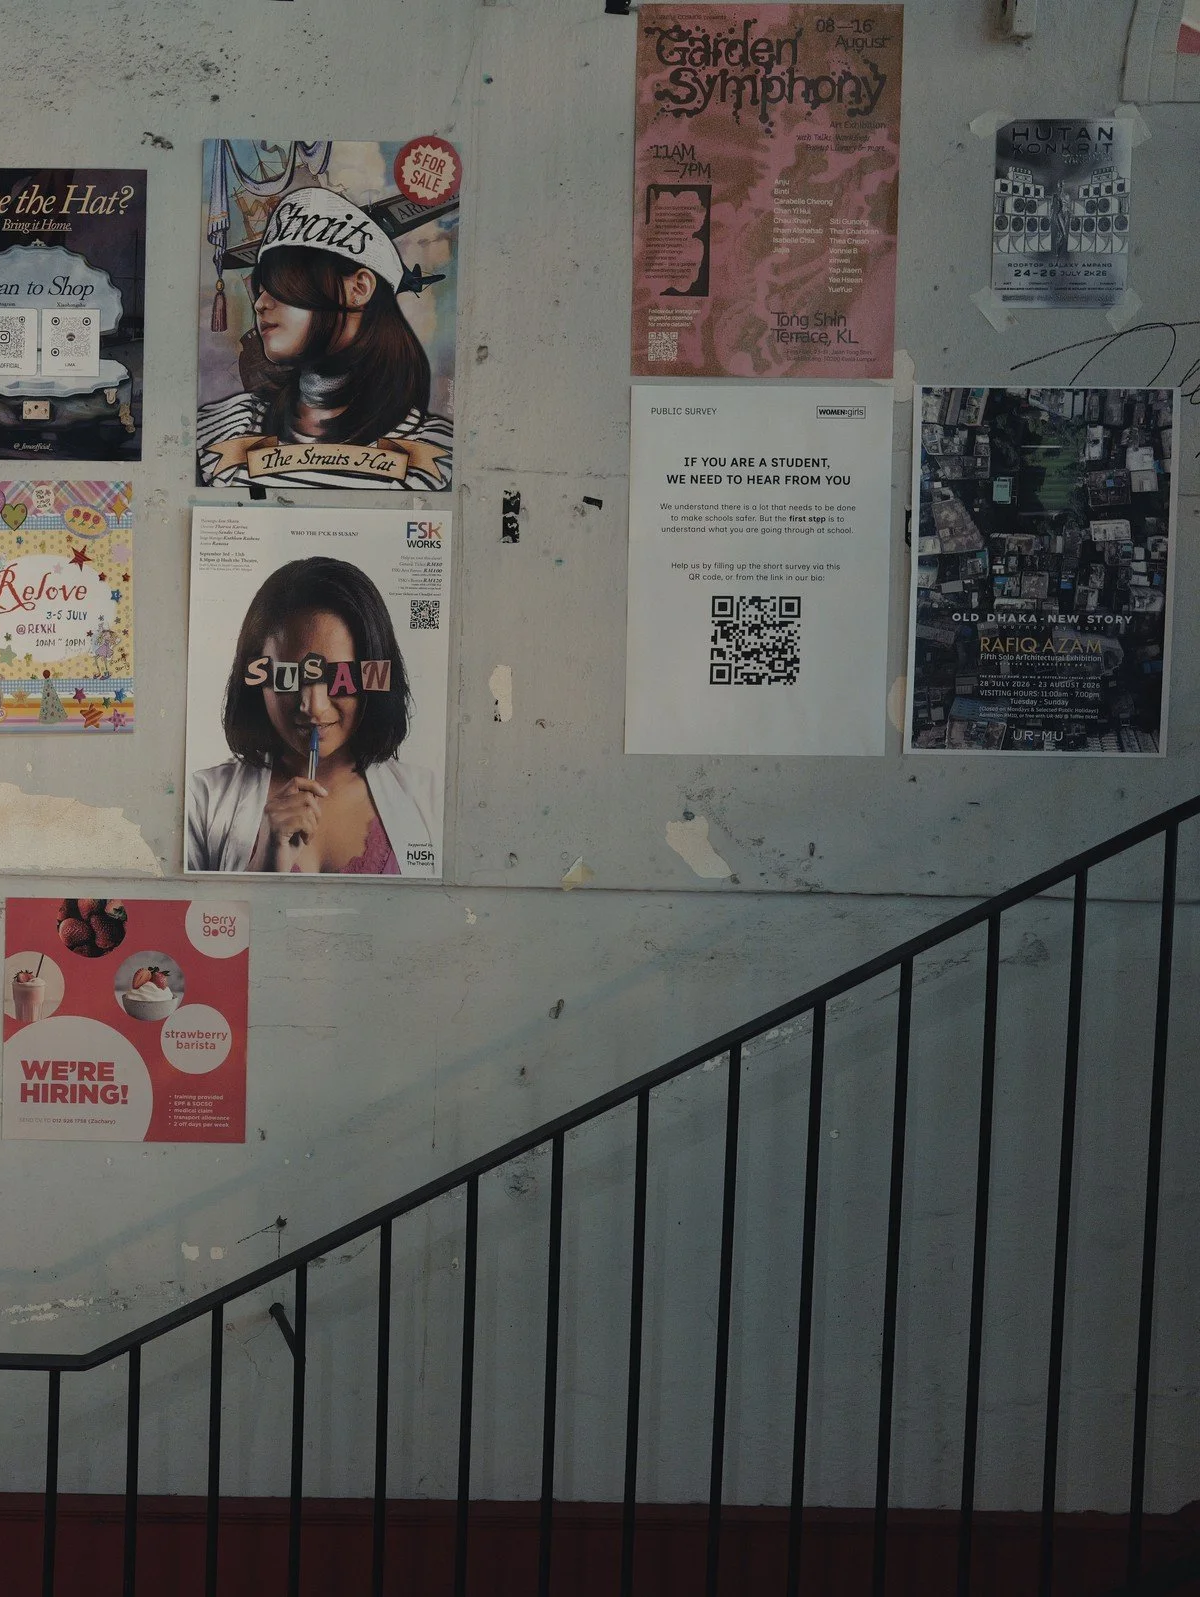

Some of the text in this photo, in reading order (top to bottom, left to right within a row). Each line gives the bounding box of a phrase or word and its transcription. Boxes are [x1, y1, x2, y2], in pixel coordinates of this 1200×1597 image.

[645, 19, 803, 68] Garden
[835, 35, 891, 51] August
[655, 67, 886, 121] Symphony
[1012, 127, 1113, 141] HUTAN
[1012, 143, 1113, 154] KONKRIT
[410, 171, 441, 194] SALE
[17, 185, 56, 214] the
[58, 184, 135, 215] Hat?
[2, 218, 72, 234] Bring it Home.
[264, 203, 374, 255] Straits
[27, 279, 43, 296] to
[48, 276, 94, 300] Shop
[770, 310, 846, 329] Tong Shin
[770, 328, 859, 347] Terrace, KL
[261, 447, 397, 472] The Straits Hat
[684, 457, 830, 469] IF YOU ARE A STUDENT,
[667, 475, 851, 485] WE NEED TO HEAR FROM YOU
[808, 516, 826, 524] step
[406, 521, 442, 539] FSK
[407, 540, 442, 549] WORKS
[66, 610, 87, 621] JULY
[952, 613, 979, 622] OLD
[1087, 615, 1132, 624] STORY
[981, 637, 1102, 653] RAFIQ AZAM
[245, 655, 391, 697] SUSAN
[1013, 730, 1064, 741] UR-MU
[203, 912, 237, 927] berry
[164, 1030, 228, 1042] strawberry
[176, 1040, 216, 1050] barista
[21, 1083, 128, 1104] HIRING!
